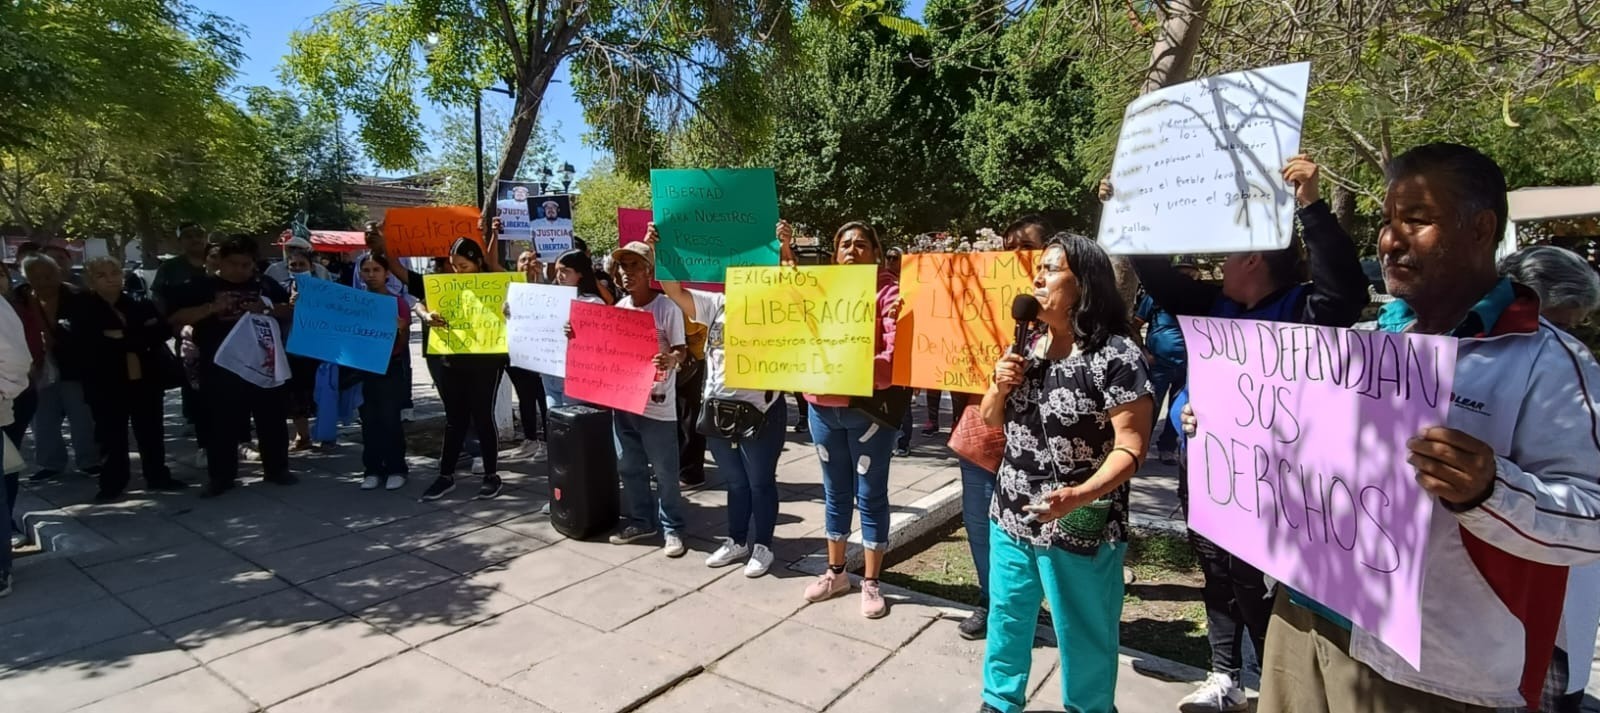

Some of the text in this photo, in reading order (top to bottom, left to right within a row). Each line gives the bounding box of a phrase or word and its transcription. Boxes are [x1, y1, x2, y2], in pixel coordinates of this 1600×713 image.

[655, 178, 724, 200] LIBERTAD
[536, 229, 569, 237] JUSTICIA
[538, 243, 570, 251] LIBERTAD
[733, 270, 818, 287] EXIGIMOS
[744, 290, 874, 326] LIBERACIÓN
[752, 336, 807, 348] nuestros
[1191, 318, 1440, 409] SOLO DEFENDIAN
[1235, 373, 1301, 445] SUS
[1205, 432, 1400, 575] DERCHOS
